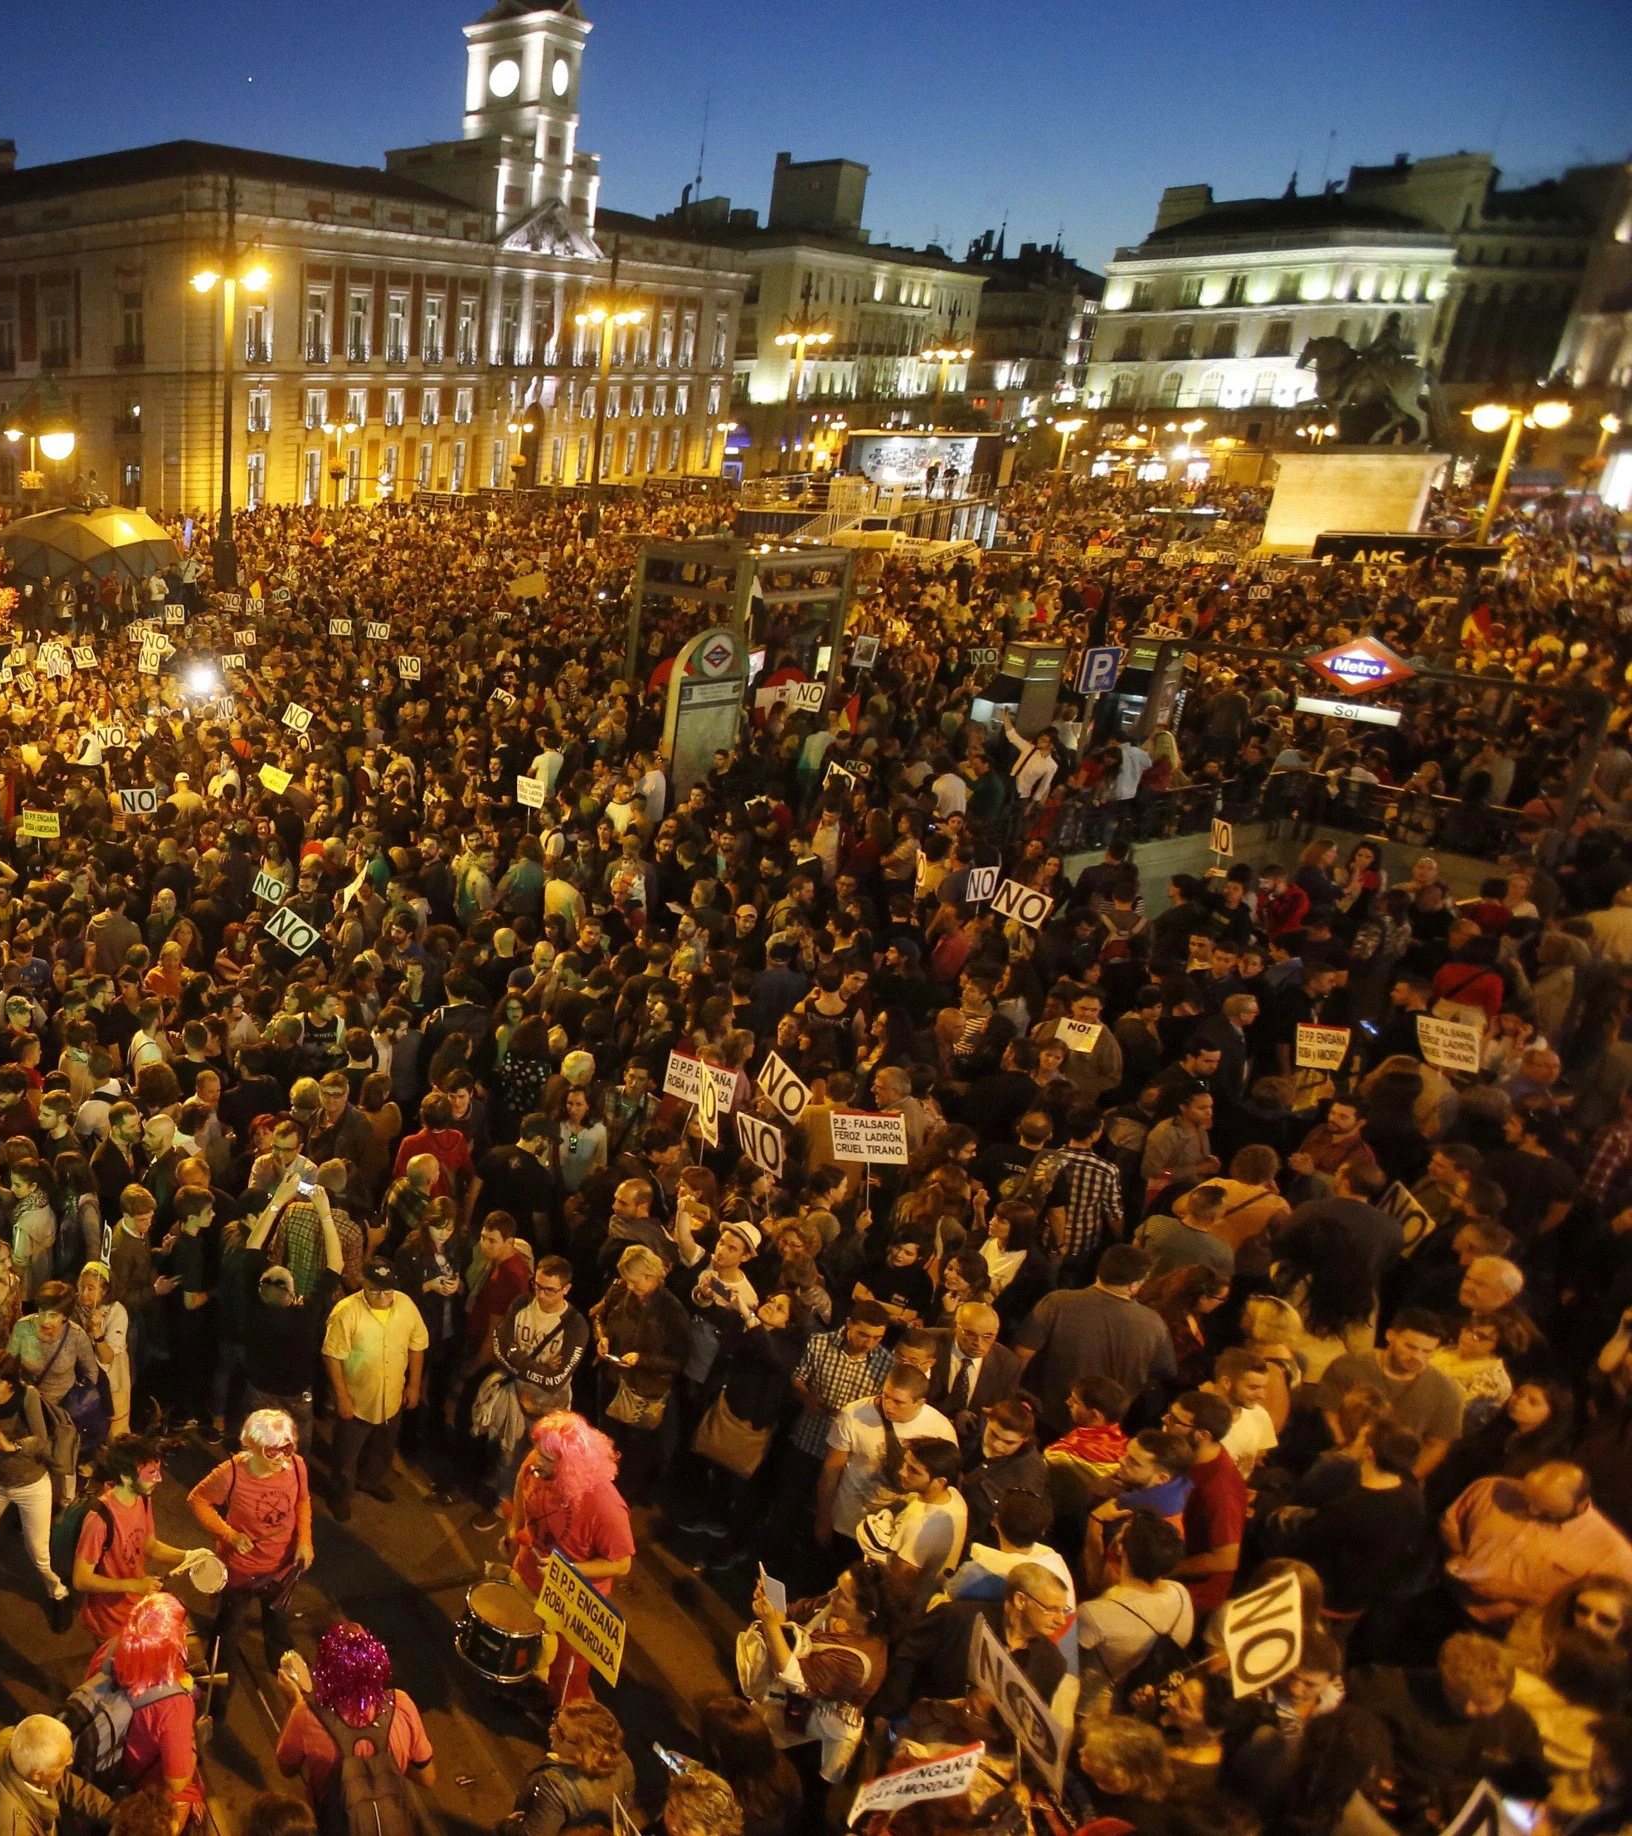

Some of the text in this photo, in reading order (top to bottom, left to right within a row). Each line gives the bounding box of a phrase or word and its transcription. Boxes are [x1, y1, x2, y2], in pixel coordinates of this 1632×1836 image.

[1140, 548, 1155, 557] NO
[1219, 553, 1236, 564] NO
[1264, 571, 1284, 581] NO
[274, 590, 289, 601] NO
[1250, 586, 1270, 597] NO
[225, 595, 240, 607] NO
[247, 599, 264, 611] NO
[167, 606, 183, 618] NO
[331, 621, 350, 633] NO
[370, 624, 388, 637] NO
[145, 635, 167, 650] NO
[236, 632, 255, 645] NO
[74, 650, 93, 663] NO
[140, 651, 158, 668] NO
[223, 656, 245, 669] NO
[972, 650, 996, 662] NO
[400, 658, 419, 673] NO
[1089, 653, 1113, 689] P
[1334, 658, 1380, 676] Metro
[18, 673, 35, 690] NO
[797, 684, 822, 703] NO
[219, 699, 234, 717] NO
[1334, 705, 1359, 718] Sol
[286, 707, 309, 730] NO
[97, 729, 124, 746] NO
[846, 760, 869, 774] NO
[121, 791, 156, 812] NO
[1212, 820, 1229, 852] NO
[257, 875, 284, 900] NO
[970, 870, 994, 898] NO
[997, 881, 1045, 922] NO
[272, 911, 314, 951] NO
[1068, 1022, 1091, 1036] NO!
[670, 1058, 679, 1070] El
[679, 1061, 693, 1077] P.P.
[668, 1075, 685, 1089] ROBA
[759, 1059, 806, 1117] NO
[854, 1120, 902, 1131] FALSARIO,
[740, 1115, 781, 1171] NO
[835, 1131, 903, 1144] FEROZ LADRÓN,
[836, 1143, 905, 1156] CRUEL TIRANO.
[527, 1370, 544, 1384] LOST
[549, 1561, 621, 1649] El P.P. ENGAÑA,
[541, 1583, 565, 1618] ROBA
[571, 1612, 617, 1671] AMORDAZA.
[1229, 1579, 1296, 1684] NO
[979, 1637, 1058, 1764] NO
